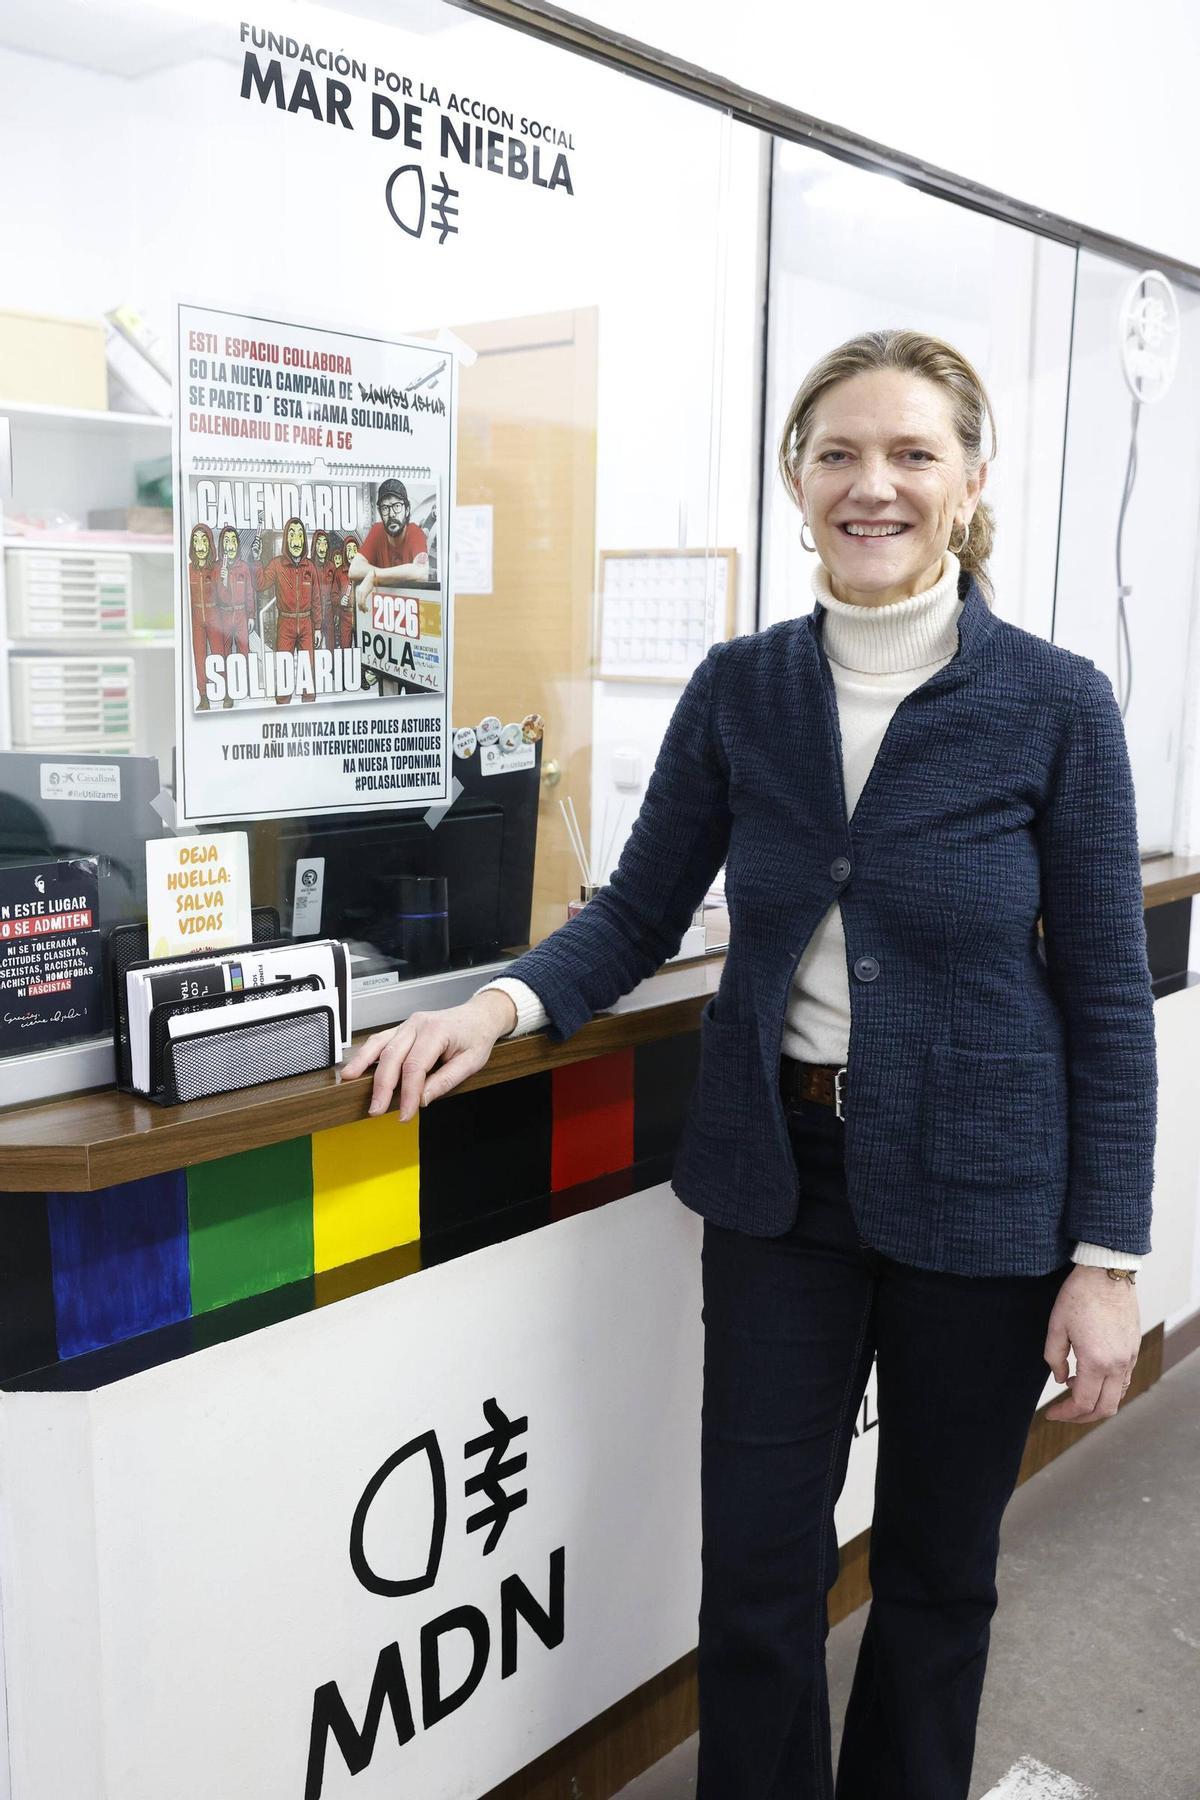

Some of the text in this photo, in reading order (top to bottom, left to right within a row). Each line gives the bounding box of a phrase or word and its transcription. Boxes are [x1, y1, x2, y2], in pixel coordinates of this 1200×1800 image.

[239, 22, 575, 151] FUNDACIÓN POR LA ACCION SOCIAL
[240, 51, 574, 196] MAR DE NIEBLA
[189, 330, 352, 375] ESTI ESPACIU COLLABORA
[189, 358, 208, 380] CO
[211, 361, 227, 382] LA
[231, 364, 272, 389] NUEVA
[276, 371, 336, 398] CAMPAÑA
[339, 380, 353, 400] DE
[189, 385, 205, 406] SE
[209, 388, 250, 412] PARTE
[274, 397, 303, 419] ESTA
[306, 401, 348, 425] TRAMA
[351, 408, 414, 435] SOLIDARIA,
[189, 412, 353, 450] CALENDARIU DE PARÉ A 5€
[196, 480, 359, 532] CALENDARIU
[373, 594, 419, 638] 2026
[362, 630, 416, 671] POLA
[205, 647, 362, 702] SOLIDARIU
[262, 718, 441, 739] OTRA XUNTAZA DE LES POLES ASTURES
[222, 736, 441, 760] Y OTRU AÑU MÁS INTERVENCIONES COMIQUES
[343, 754, 441, 773] NA NUESA TOPONIMIA
[355, 772, 441, 792] #POLASALUMENTAL
[179, 845, 218, 865] DEJA
[167, 867, 231, 890] HUELLA:
[1, 896, 87, 920] N ESTE LUGAR
[176, 890, 224, 913] SALVA
[0, 913, 89, 938] O SE ADMITEN
[178, 912, 223, 935] VIDAS
[7, 937, 77, 956] NI SE TOLERARÁN
[44, 947, 89, 961] CLASISTAS,
[0, 958, 86, 979] SEXISTAS, RACISTAS,
[0, 966, 94, 989] ACHISTAS, HOMÓFOBAS
[17, 981, 71, 997] NI FASCISTAS
[304, 1546, 565, 1800] MDN
